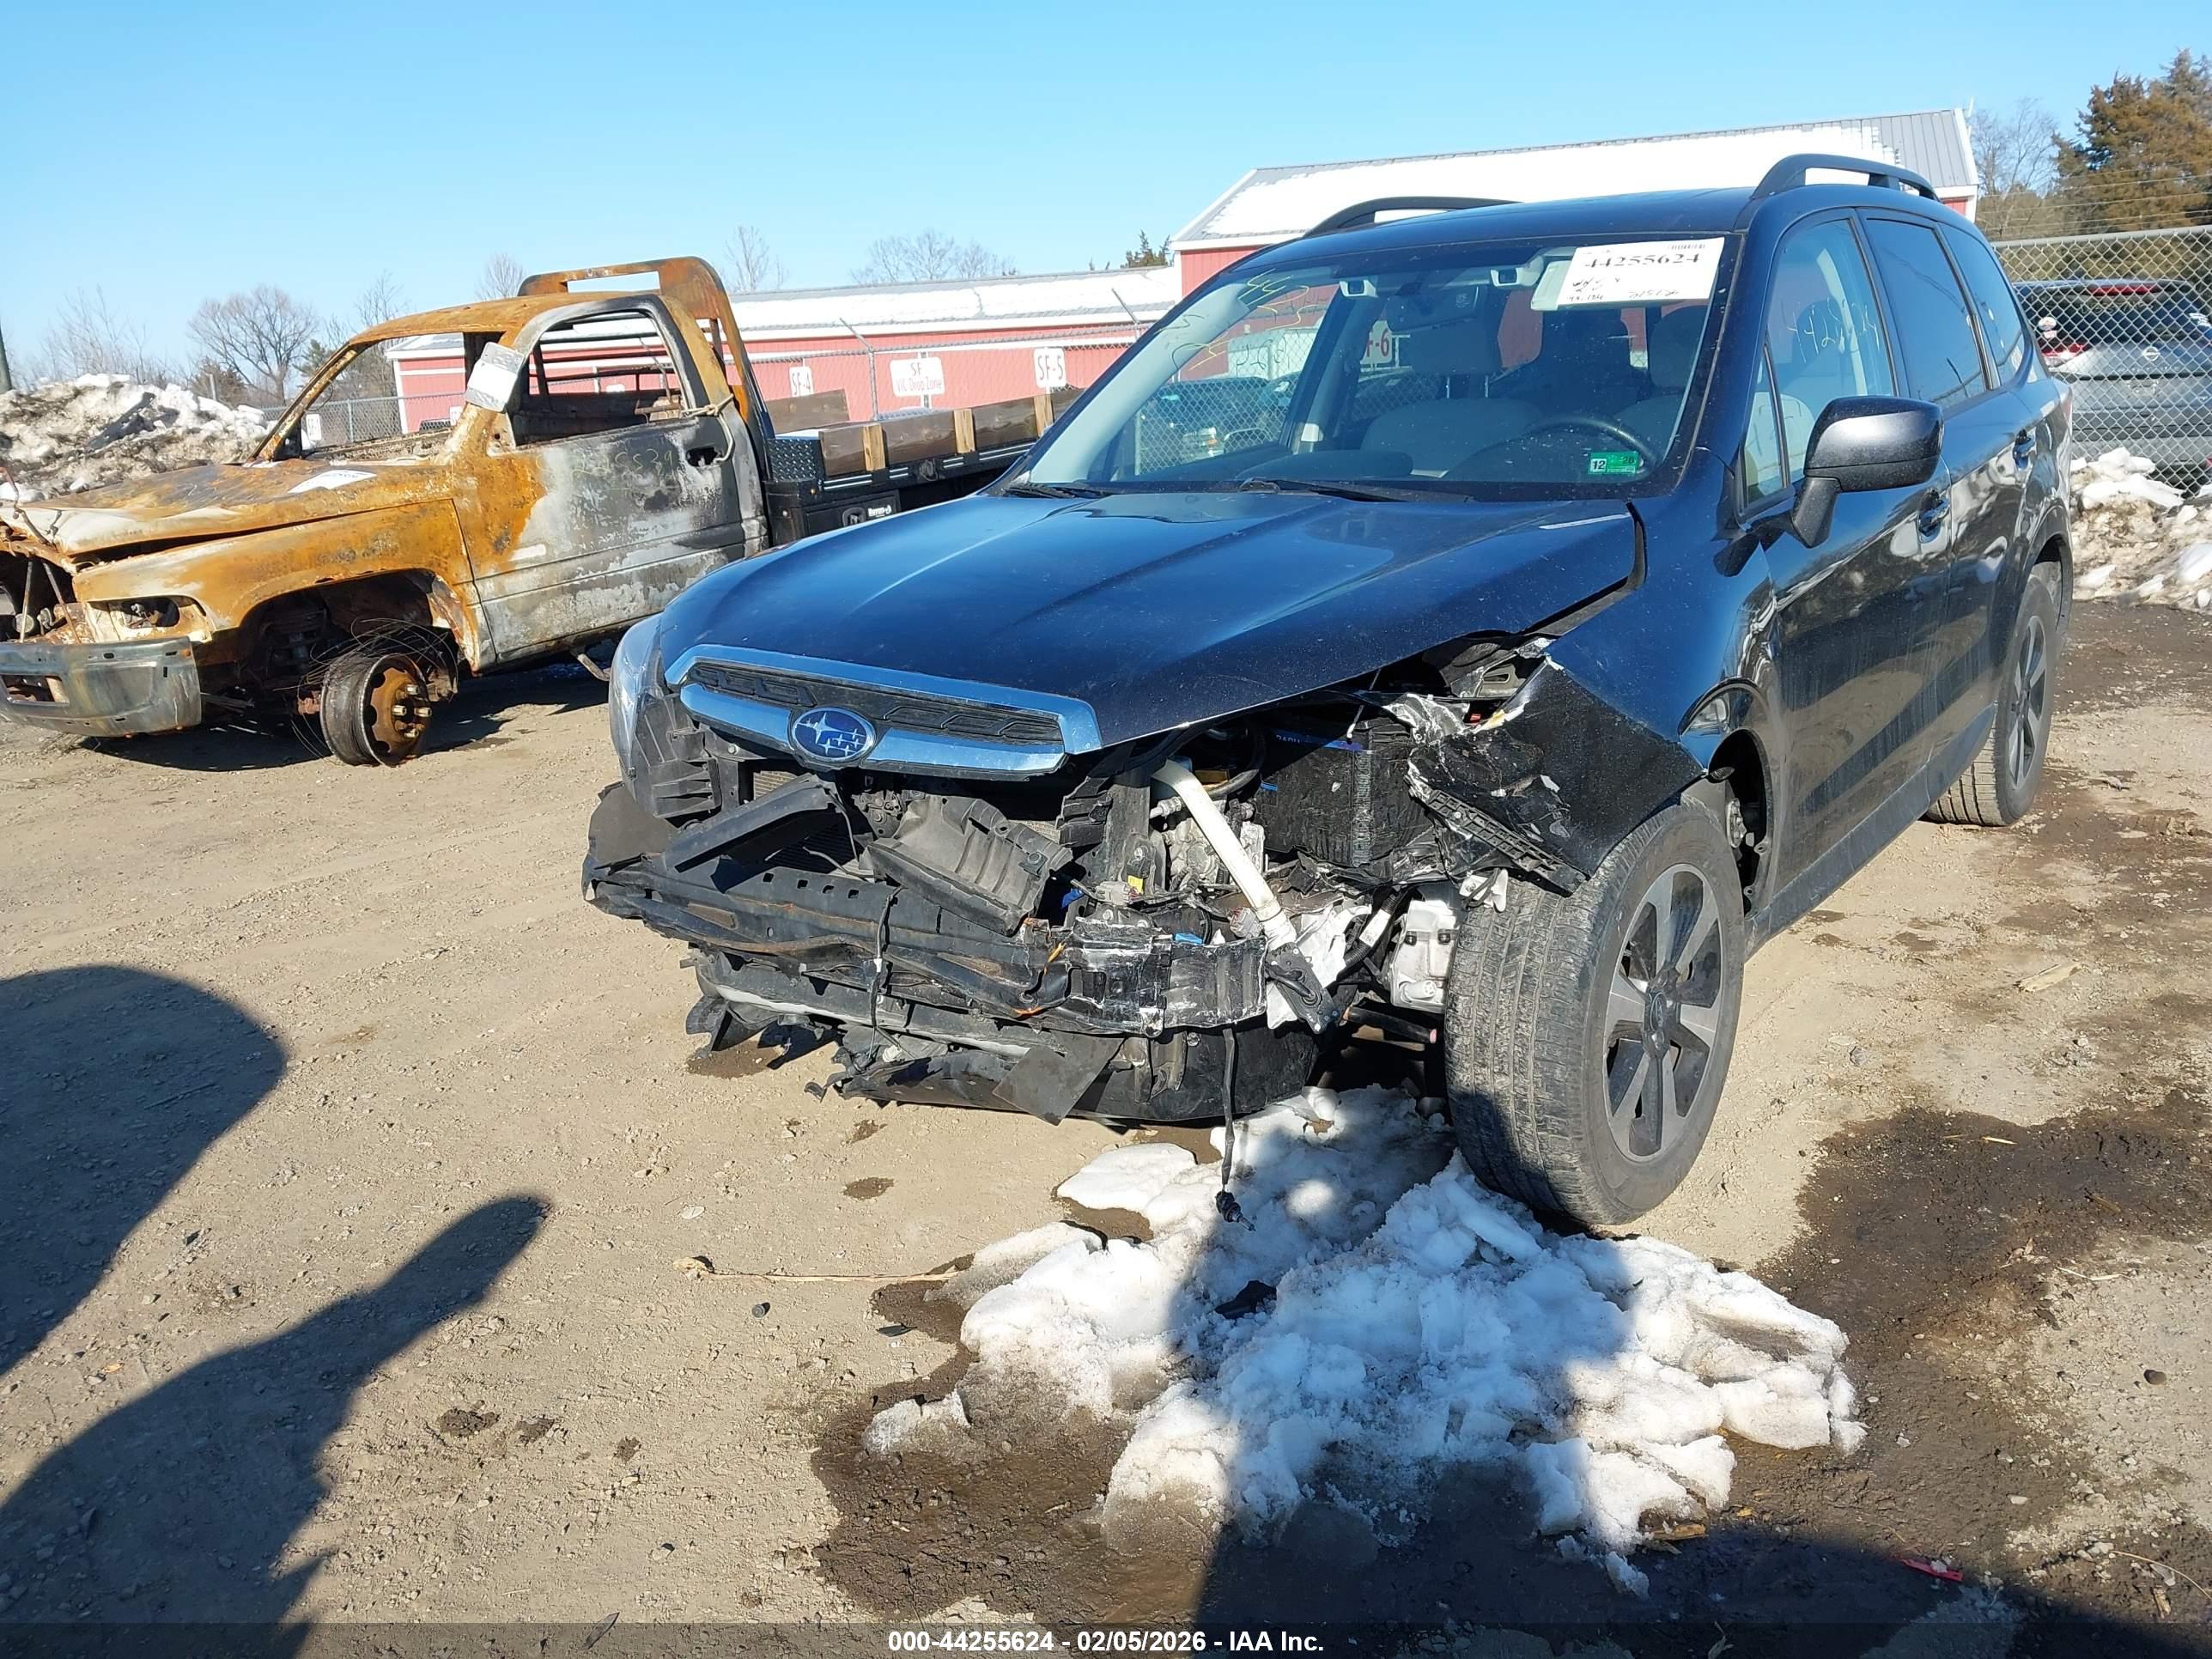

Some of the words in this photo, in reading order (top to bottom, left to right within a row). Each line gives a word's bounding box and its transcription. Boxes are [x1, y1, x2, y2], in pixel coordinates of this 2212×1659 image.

[910, 362, 921, 376] SF
[1037, 355, 1064, 380] SF-5
[1593, 459, 1606, 470] 12
